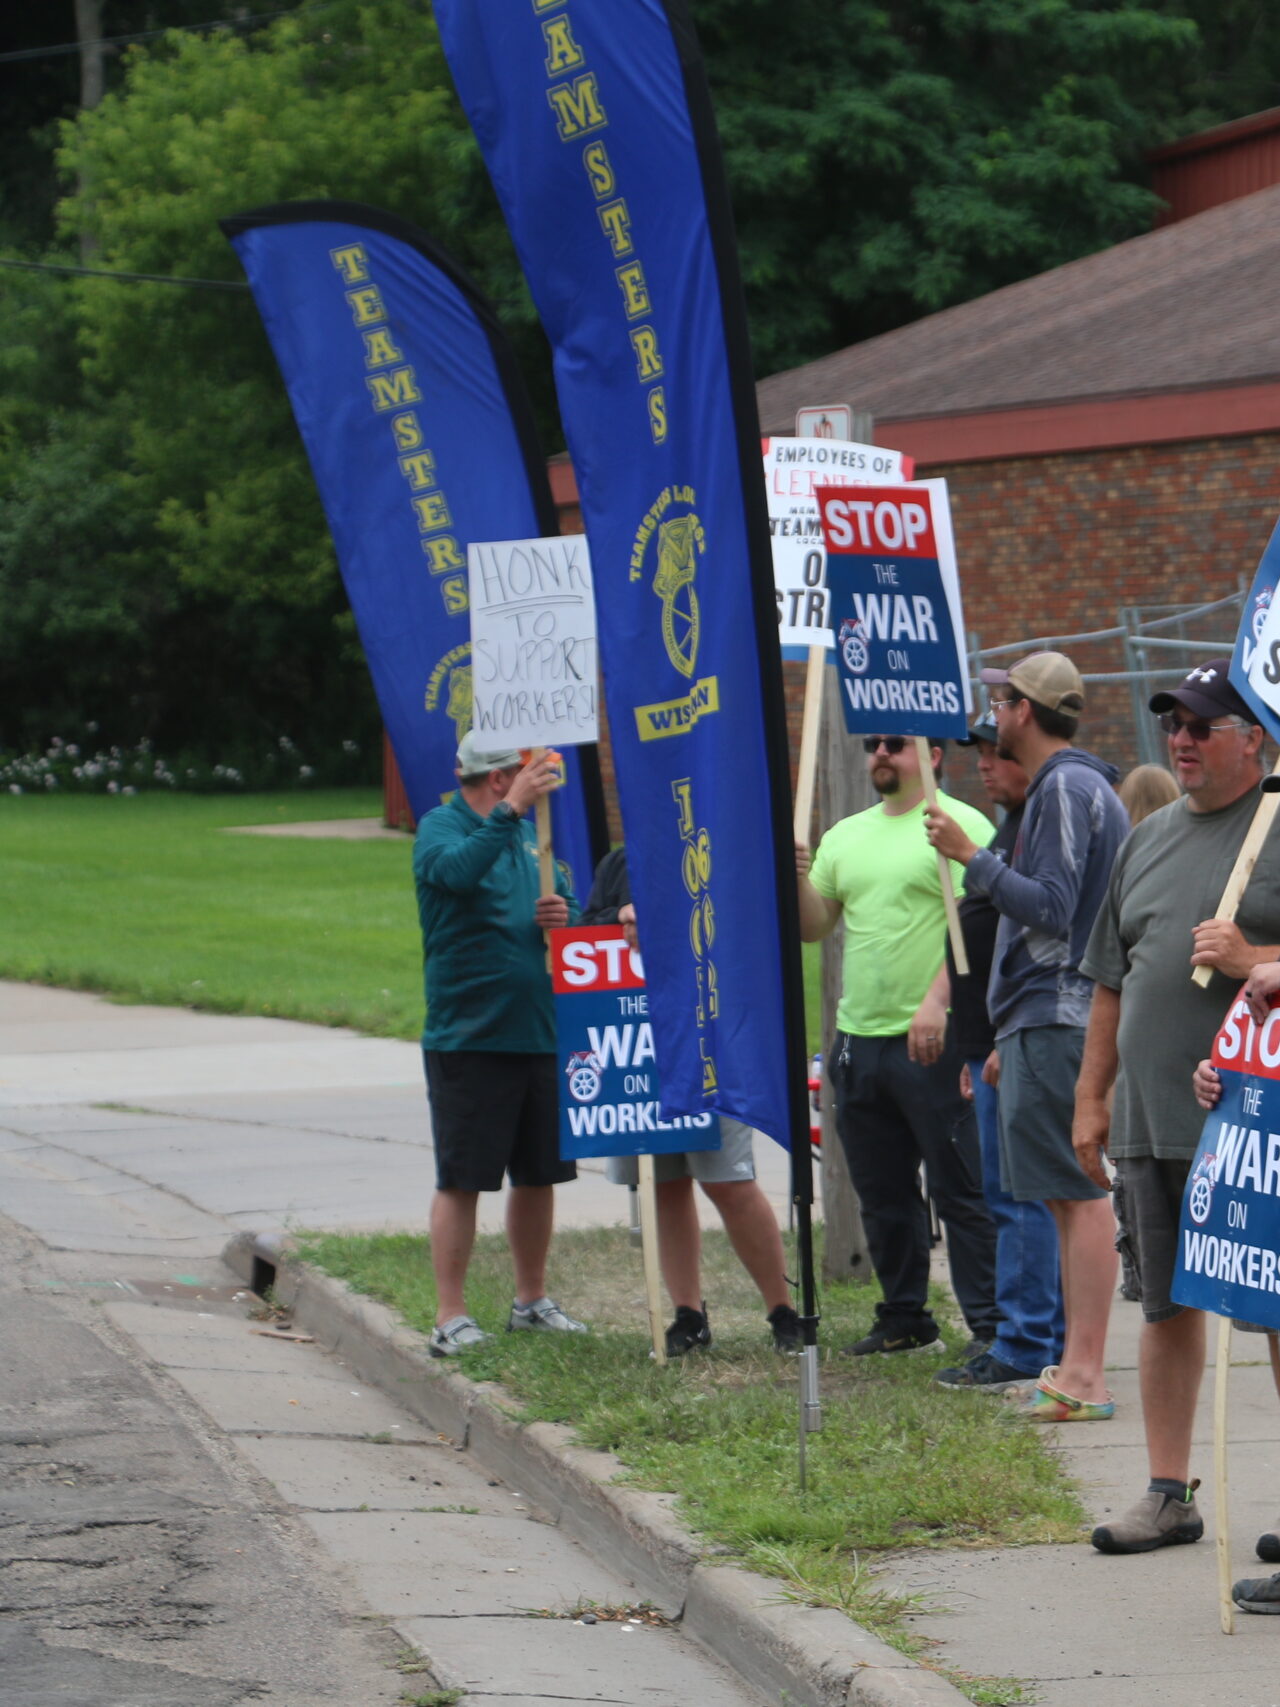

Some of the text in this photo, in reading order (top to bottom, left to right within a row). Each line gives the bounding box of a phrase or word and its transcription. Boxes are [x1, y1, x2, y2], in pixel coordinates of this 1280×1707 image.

[531, 0, 667, 444] AMSTERS
[330, 242, 469, 615] TEAMSTERS
[776, 446, 893, 475] EMPLOYEES OF
[824, 499, 928, 550] STOP
[476, 543, 590, 603] HONK
[872, 563, 899, 585] THE
[504, 610, 556, 637] TO
[853, 593, 938, 643] WAR
[475, 636, 597, 683] SUPPORT
[887, 649, 910, 671] ON
[844, 678, 961, 714] WORKERS
[617, 995, 649, 1016] THE
[587, 1022, 656, 1068] WA
[623, 1074, 650, 1095] ON
[1243, 1086, 1264, 1117] THE
[1227, 1200, 1248, 1230] ON
